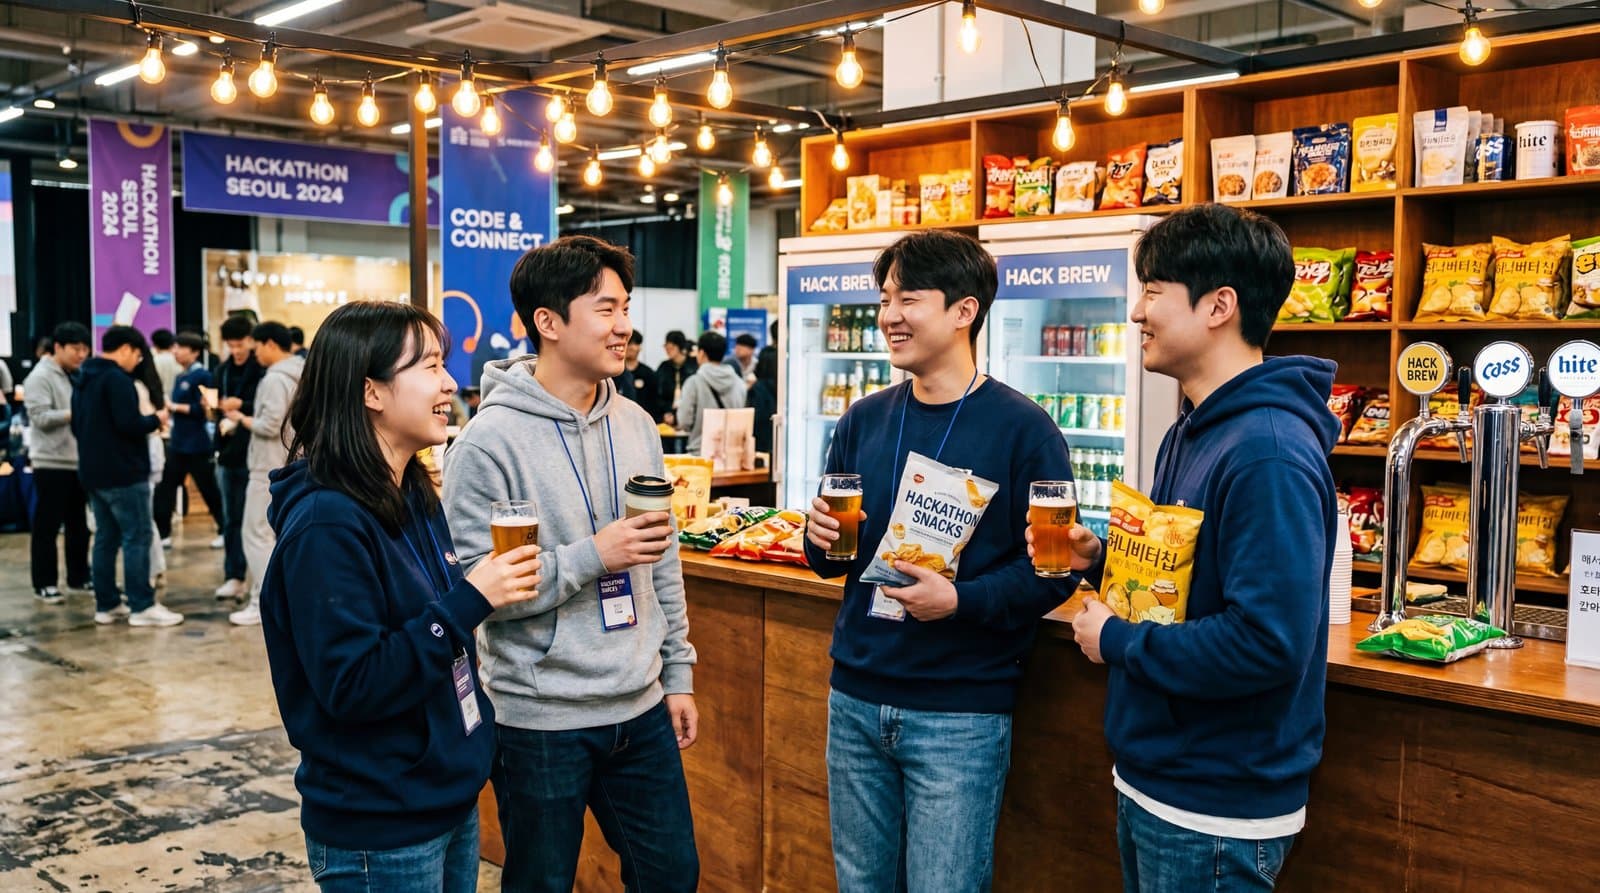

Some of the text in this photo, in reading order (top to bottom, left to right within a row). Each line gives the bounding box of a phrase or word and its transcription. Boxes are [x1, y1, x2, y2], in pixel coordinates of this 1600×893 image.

[225, 154, 349, 183] HACKATHON
[226, 176, 344, 204] SEOUL 2024
[102, 190, 120, 237] 2024
[121, 179, 139, 239] SEOUL
[141, 164, 160, 275] HACKATHON
[450, 207, 523, 231] CODE &
[450, 228, 544, 251] CONNECT
[800, 275, 840, 293] HACK
[1005, 264, 1112, 287] HACK BREW
[1407, 357, 1438, 369] HACK
[1407, 369, 1438, 381] BREW
[1558, 354, 1598, 374] hite
[905, 489, 980, 528] HACKATHON
[912, 509, 964, 539] SNACKS
